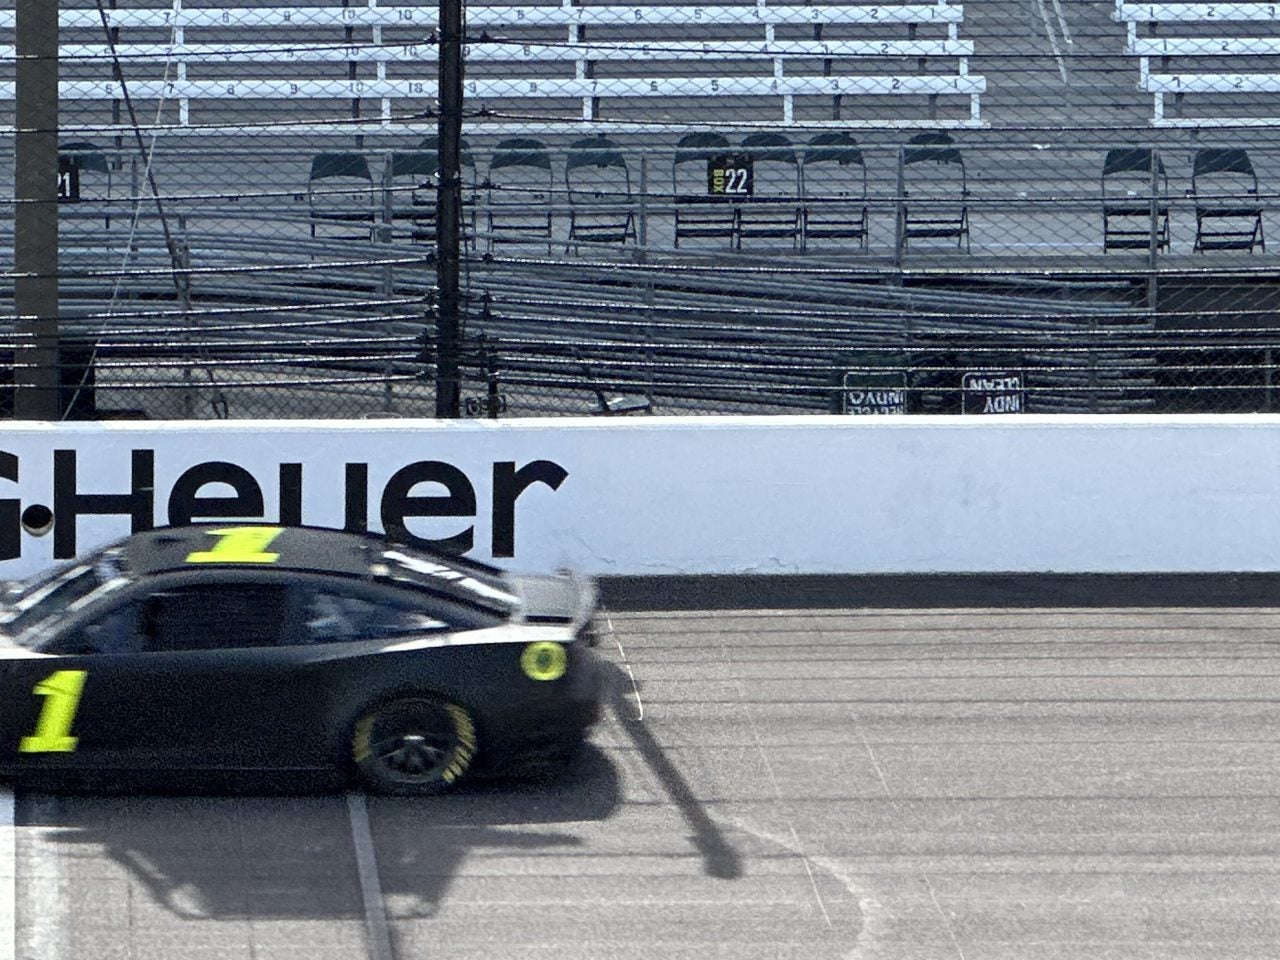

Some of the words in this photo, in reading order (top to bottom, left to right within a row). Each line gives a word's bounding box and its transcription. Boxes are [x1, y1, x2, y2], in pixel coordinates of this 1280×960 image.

[713, 169, 724, 192] BOX
[725, 168, 748, 193] 22
[983, 395, 1020, 413] INDY
[53, 449, 569, 560] Heuer
[184, 526, 287, 563] 1
[18, 670, 88, 753] 1
